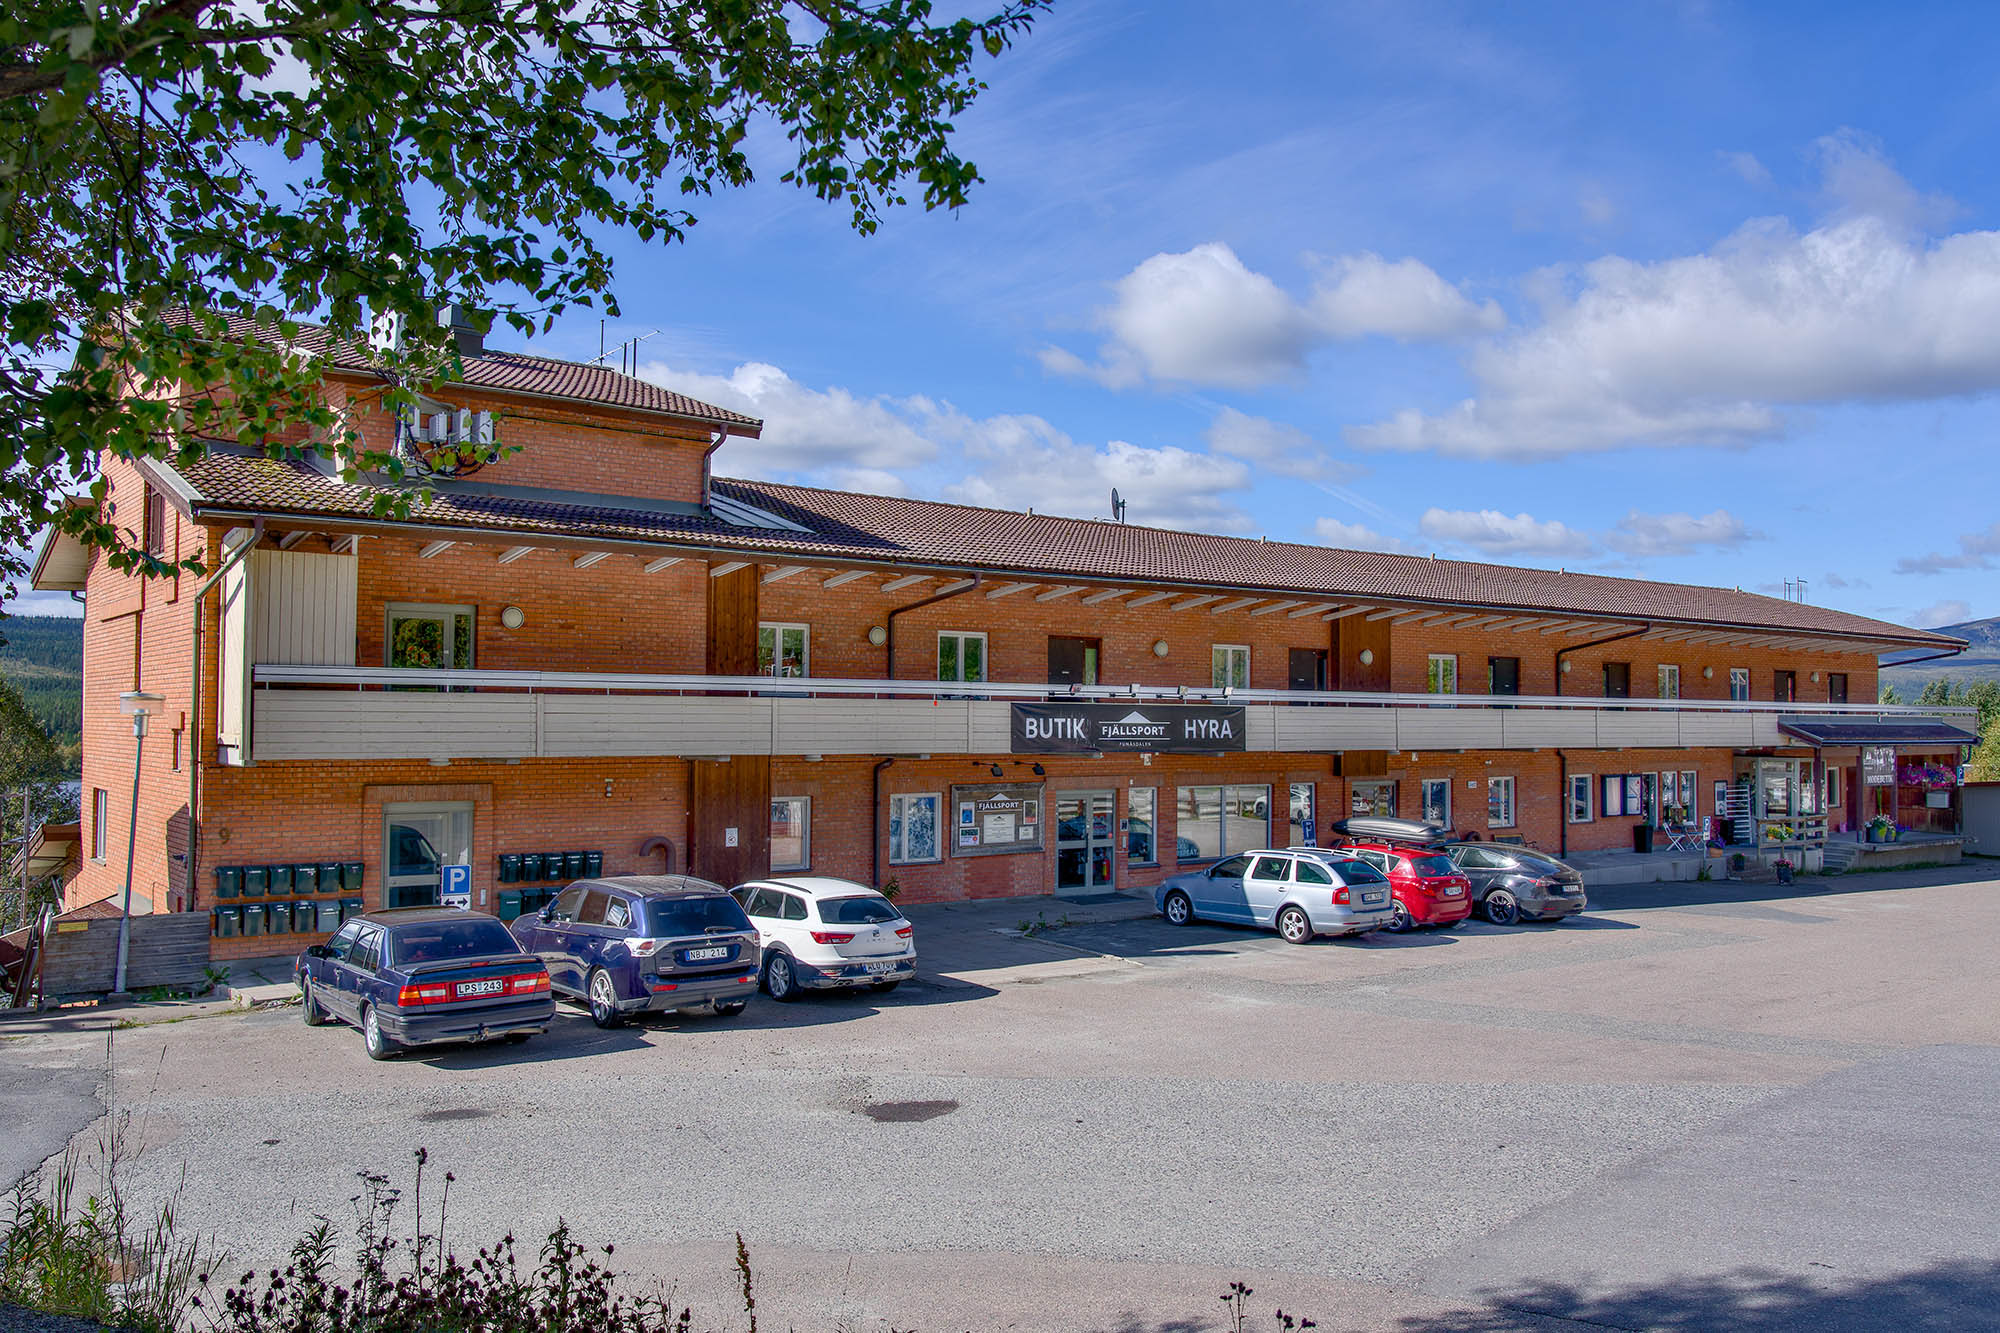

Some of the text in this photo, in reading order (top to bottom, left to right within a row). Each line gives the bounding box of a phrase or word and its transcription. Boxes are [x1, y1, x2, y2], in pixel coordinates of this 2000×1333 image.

[1025, 717, 1086, 740] BUTIK
[1102, 726, 1165, 737] FJÄLLSPORT
[1184, 719, 1233, 739] HYRA
[978, 801, 1019, 811] FJÄLLSPORT
[449, 868, 466, 892] P
[690, 947, 726, 960] NBJ 214
[458, 981, 502, 994] LPS 243
